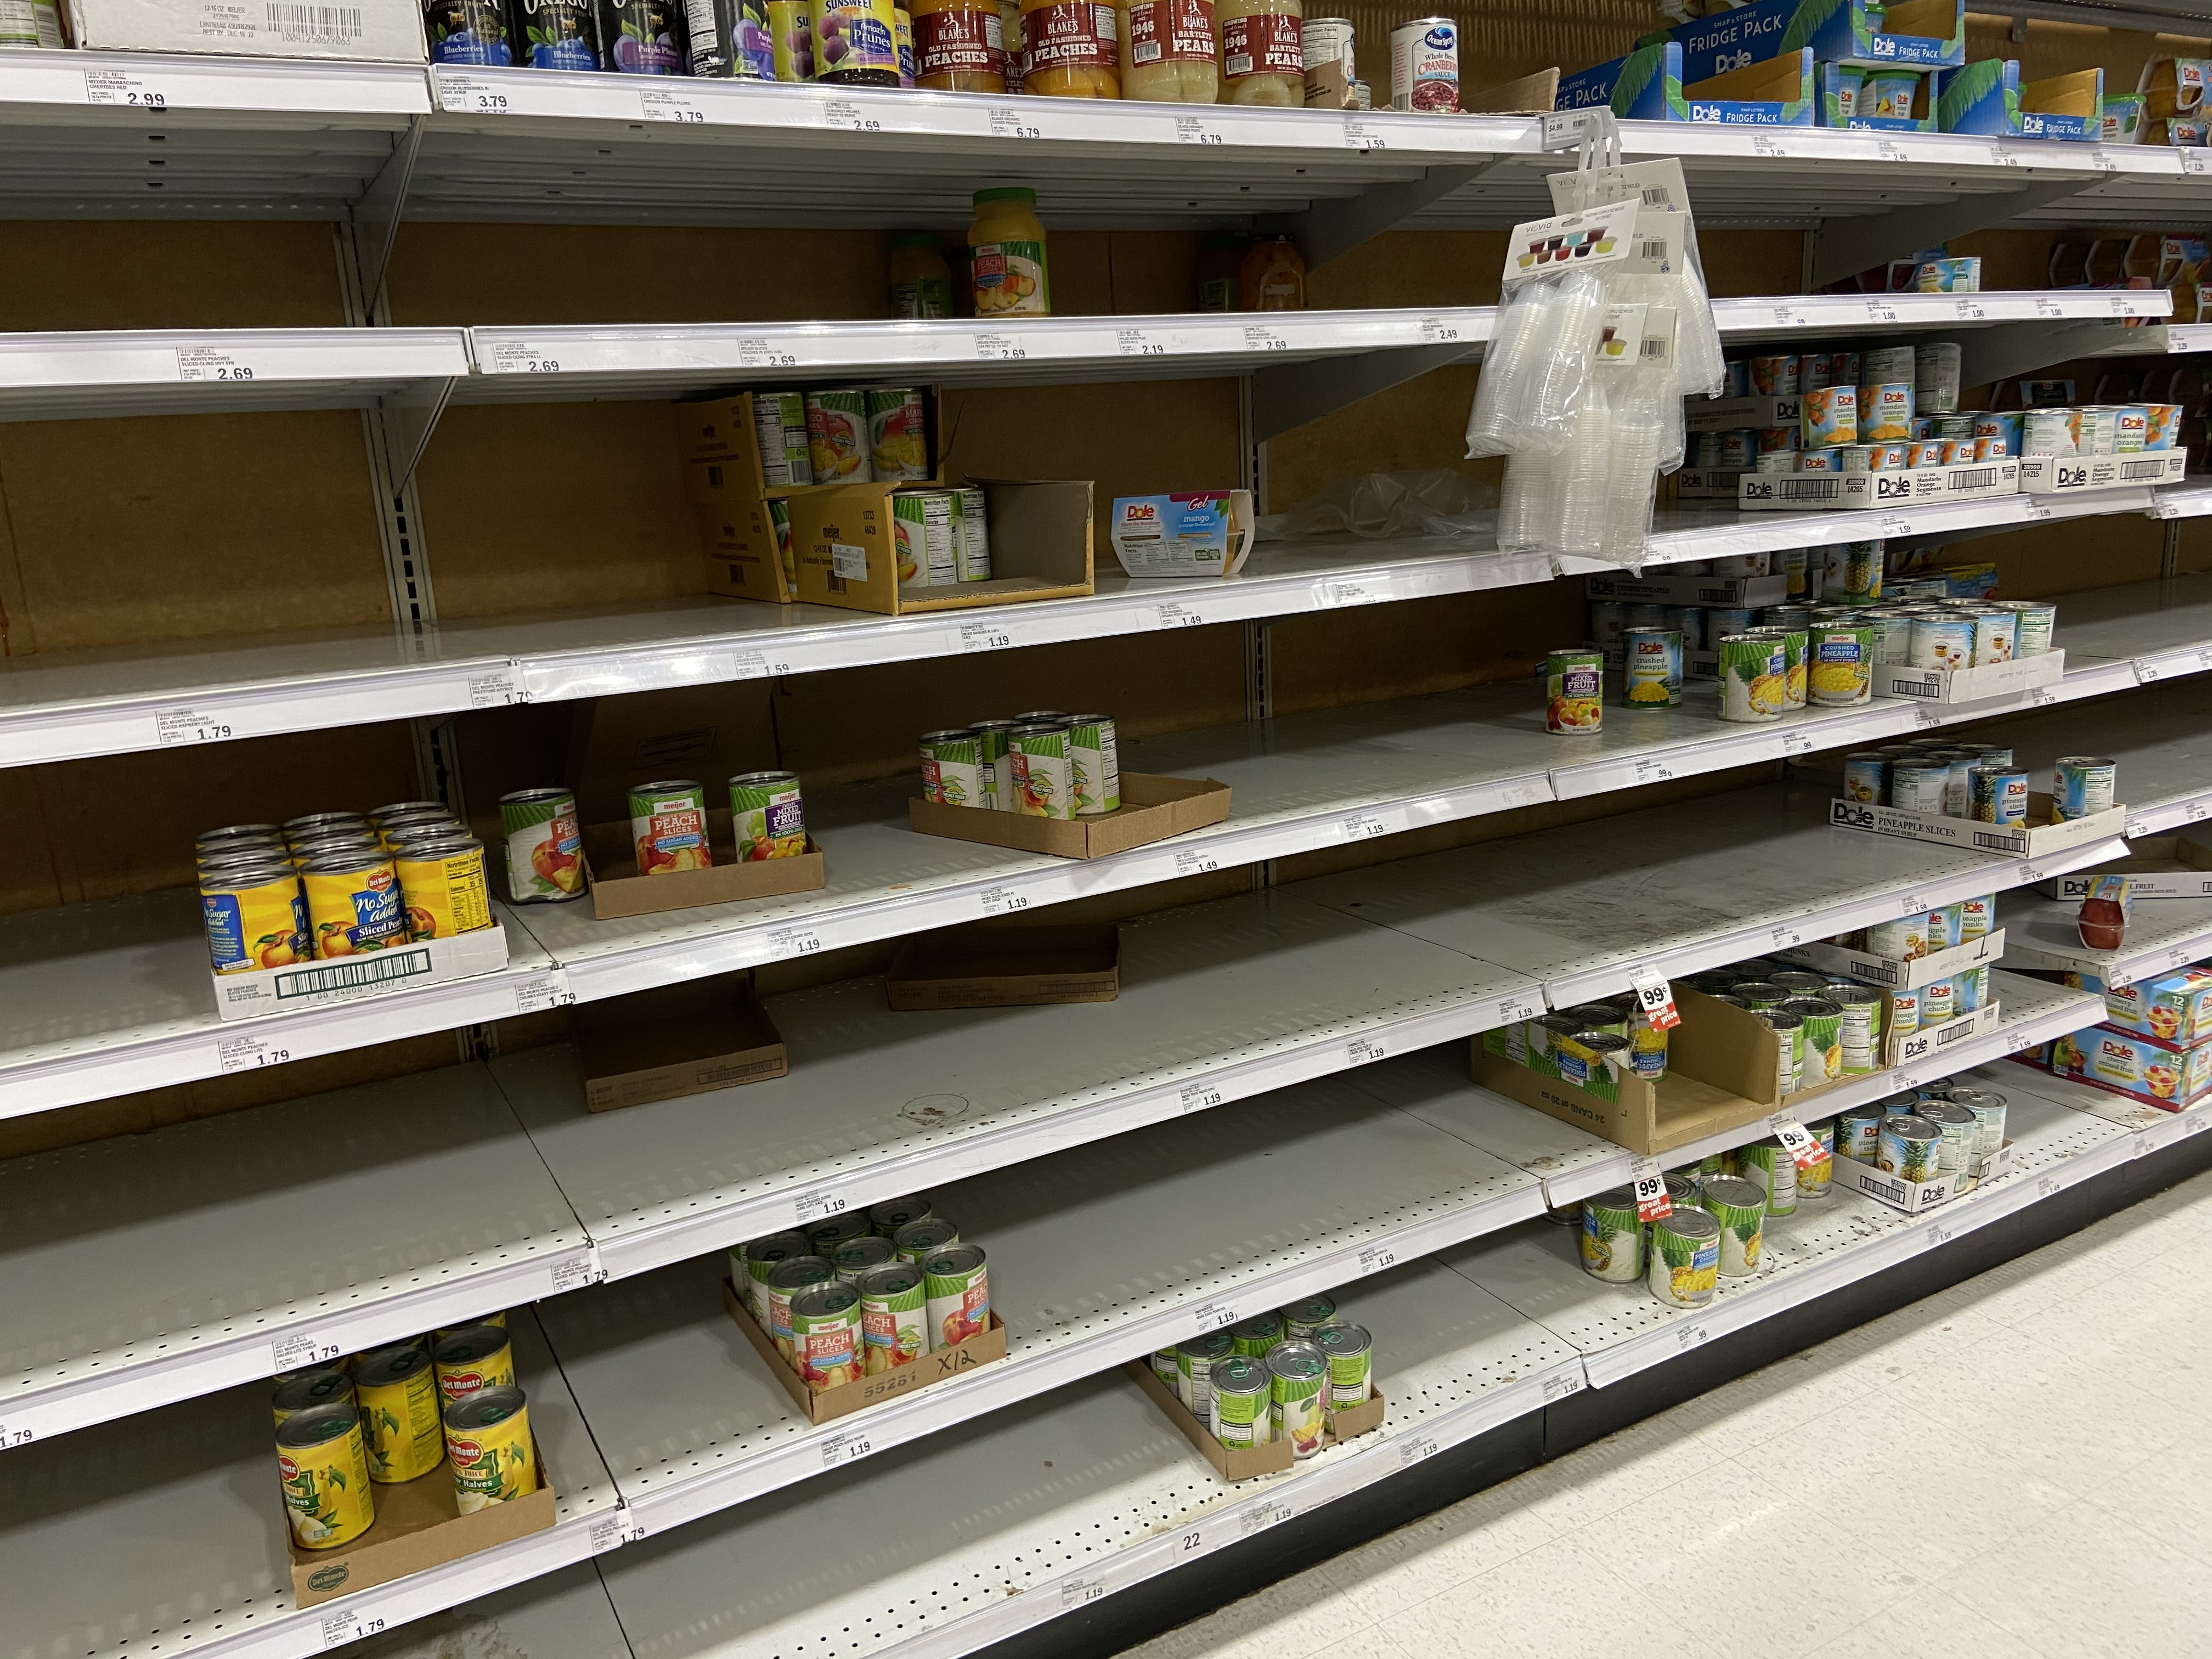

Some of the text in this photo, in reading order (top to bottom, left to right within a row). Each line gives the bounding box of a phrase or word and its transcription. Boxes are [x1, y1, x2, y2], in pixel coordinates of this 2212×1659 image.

[1183, 16, 1207, 29] BLAKE'S
[1714, 10, 1757, 29] SNAP STORE
[1047, 20, 1079, 35] BLAKE'S
[1132, 21, 1154, 37] 1946
[854, 30, 890, 48] Prunes
[939, 28, 969, 41] BLAKE'S
[1051, 35, 1091, 45] FASHIONED
[1178, 30, 1212, 41] BARTLETT
[1274, 31, 1297, 43] BLAKE'S
[1689, 14, 1782, 54] FRIDGE PACK
[1224, 35, 1248, 50] 1946
[1427, 34, 1454, 47] Ocean Spray
[1874, 37, 1895, 54] Dole
[444, 40, 483, 54] Blueberries
[638, 44, 660, 54] Purple
[1035, 43, 1098, 62] PEACHES
[1172, 40, 1214, 55] PEARS
[1269, 45, 1301, 54] BARTLETT
[1899, 46, 1938, 58] FRIDGE PACK
[553, 50, 590, 61] Blueberries
[925, 52, 988, 67] PEACHES
[1265, 53, 1303, 67] PEARS
[1425, 53, 1441, 61] Whole
[1716, 49, 1752, 75] Dole
[1569, 78, 1586, 89] STORE
[1576, 82, 1608, 103] PACK
[127, 93, 165, 105] 2.99
[478, 95, 507, 108] 3.79
[674, 111, 703, 123] 3.79
[1693, 105, 1721, 122] Dole
[1726, 112, 1777, 123] FRIDGE PACK
[854, 120, 880, 131] 2.69
[1549, 123, 1563, 132] $4.99
[2024, 116, 2043, 131] Dole
[2046, 124, 2081, 134] FRIDGE PACK
[1017, 127, 1040, 138] 6.79
[1201, 134, 1221, 144] 6.79
[1366, 139, 1385, 149] 1.59
[1883, 312, 1895, 320] 1.00
[1440, 329, 1457, 340] 2.49
[1142, 345, 1164, 355] 2.19
[1266, 341, 1287, 351] 2.69
[1002, 349, 1025, 359] 2.69
[528, 360, 559, 373] 2.69
[769, 356, 795, 366] 2.69
[218, 367, 253, 380] 2.69
[1838, 395, 1854, 404] Dole
[1884, 392, 1904, 402] Dole
[2122, 418, 2144, 427] Dole
[1805, 459, 1826, 467] Dole
[2059, 466, 2085, 483] Dole
[1747, 482, 1863, 496] Dole 14205
[1878, 476, 1910, 495] Dole
[1188, 495, 1209, 512] Gel
[1127, 505, 1155, 518] Dole
[1183, 515, 1210, 523] mango
[1182, 616, 1201, 626] 1.49
[989, 635, 1009, 647] 1.19
[1638, 642, 1663, 652] Dole
[764, 663, 790, 675] 1.59
[1633, 663, 1668, 672] pineapple
[1567, 680, 1595, 690] FRUIT
[197, 725, 232, 740] 1.79
[2008, 783, 2027, 792] Dole
[779, 792, 796, 802] meijer
[664, 801, 686, 811] meijer
[776, 804, 799, 817] MIXED
[773, 811, 802, 827] FRUIT
[1833, 802, 1874, 825] Dole
[654, 814, 698, 831] PEACH
[1878, 816, 1956, 838] PINEAPPLE SLICES
[663, 825, 692, 835] SLICES
[1367, 825, 1384, 835] 1.19
[447, 859, 468, 869] Nutrition
[1198, 860, 1218, 872] 1.49
[357, 896, 376, 913] No
[1007, 897, 1027, 910] 1.19
[371, 905, 398, 922] Added
[359, 922, 387, 937] Sliced
[798, 939, 820, 952] 1.19
[335, 986, 363, 996] 24000
[369, 980, 396, 990] 13207
[1930, 986, 1950, 995] Dole
[549, 992, 577, 1006] 1.79
[2111, 996, 2131, 1007] cherry
[2172, 996, 2185, 1006] 12
[1519, 1008, 1532, 1018] 1.19
[1648, 1006, 1669, 1022] great
[2124, 1005, 2138, 1015] fruit
[1660, 1010, 1678, 1025] price
[1369, 1048, 1384, 1059] 1.19
[2103, 1040, 2133, 1057] Dole
[257, 1050, 290, 1065] 1.79
[2106, 1056, 2128, 1066] cherry
[2170, 1054, 2182, 1065] 12
[2118, 1064, 2135, 1073] fruit
[1204, 1093, 1220, 1105] 1.19
[1551, 1094, 1561, 1103] 20
[1571, 1103, 1594, 1118] CANS
[1595, 1114, 1605, 1124] 24
[1791, 1144, 1813, 1162] great
[1804, 1146, 1825, 1163] price
[1922, 1186, 1945, 1202] Dole
[823, 1199, 845, 1214] 1.19
[1639, 1198, 1661, 1213] great
[1650, 1203, 1671, 1217] price
[1940, 1232, 1951, 1242] 1.59
[1379, 1254, 1395, 1266] 1.19
[583, 1269, 608, 1285] 1.79
[1217, 1312, 1235, 1324] 1.19
[817, 1322, 839, 1331] meijer
[809, 1334, 850, 1350] PEACH
[309, 1345, 339, 1363] 1.79
[817, 1344, 844, 1355] SLICES
[443, 1378, 481, 1389] Del Monte
[864, 1372, 918, 1398] 55281
[1564, 1382, 1578, 1393] 1.19
[0, 1429, 32, 1448] 1.79
[456, 1446, 479, 1457] Monte
[850, 1441, 871, 1457] 1.19
[1423, 1443, 1438, 1458] 1.19
[464, 1469, 483, 1477] JUICE
[463, 1479, 493, 1488] Halves
[1274, 1508, 1292, 1522] 1.19
[620, 1527, 645, 1543] 1.79
[1183, 1532, 1201, 1551] 22
[1085, 1587, 1103, 1600] 1.19
[356, 1619, 385, 1638] 1.79
